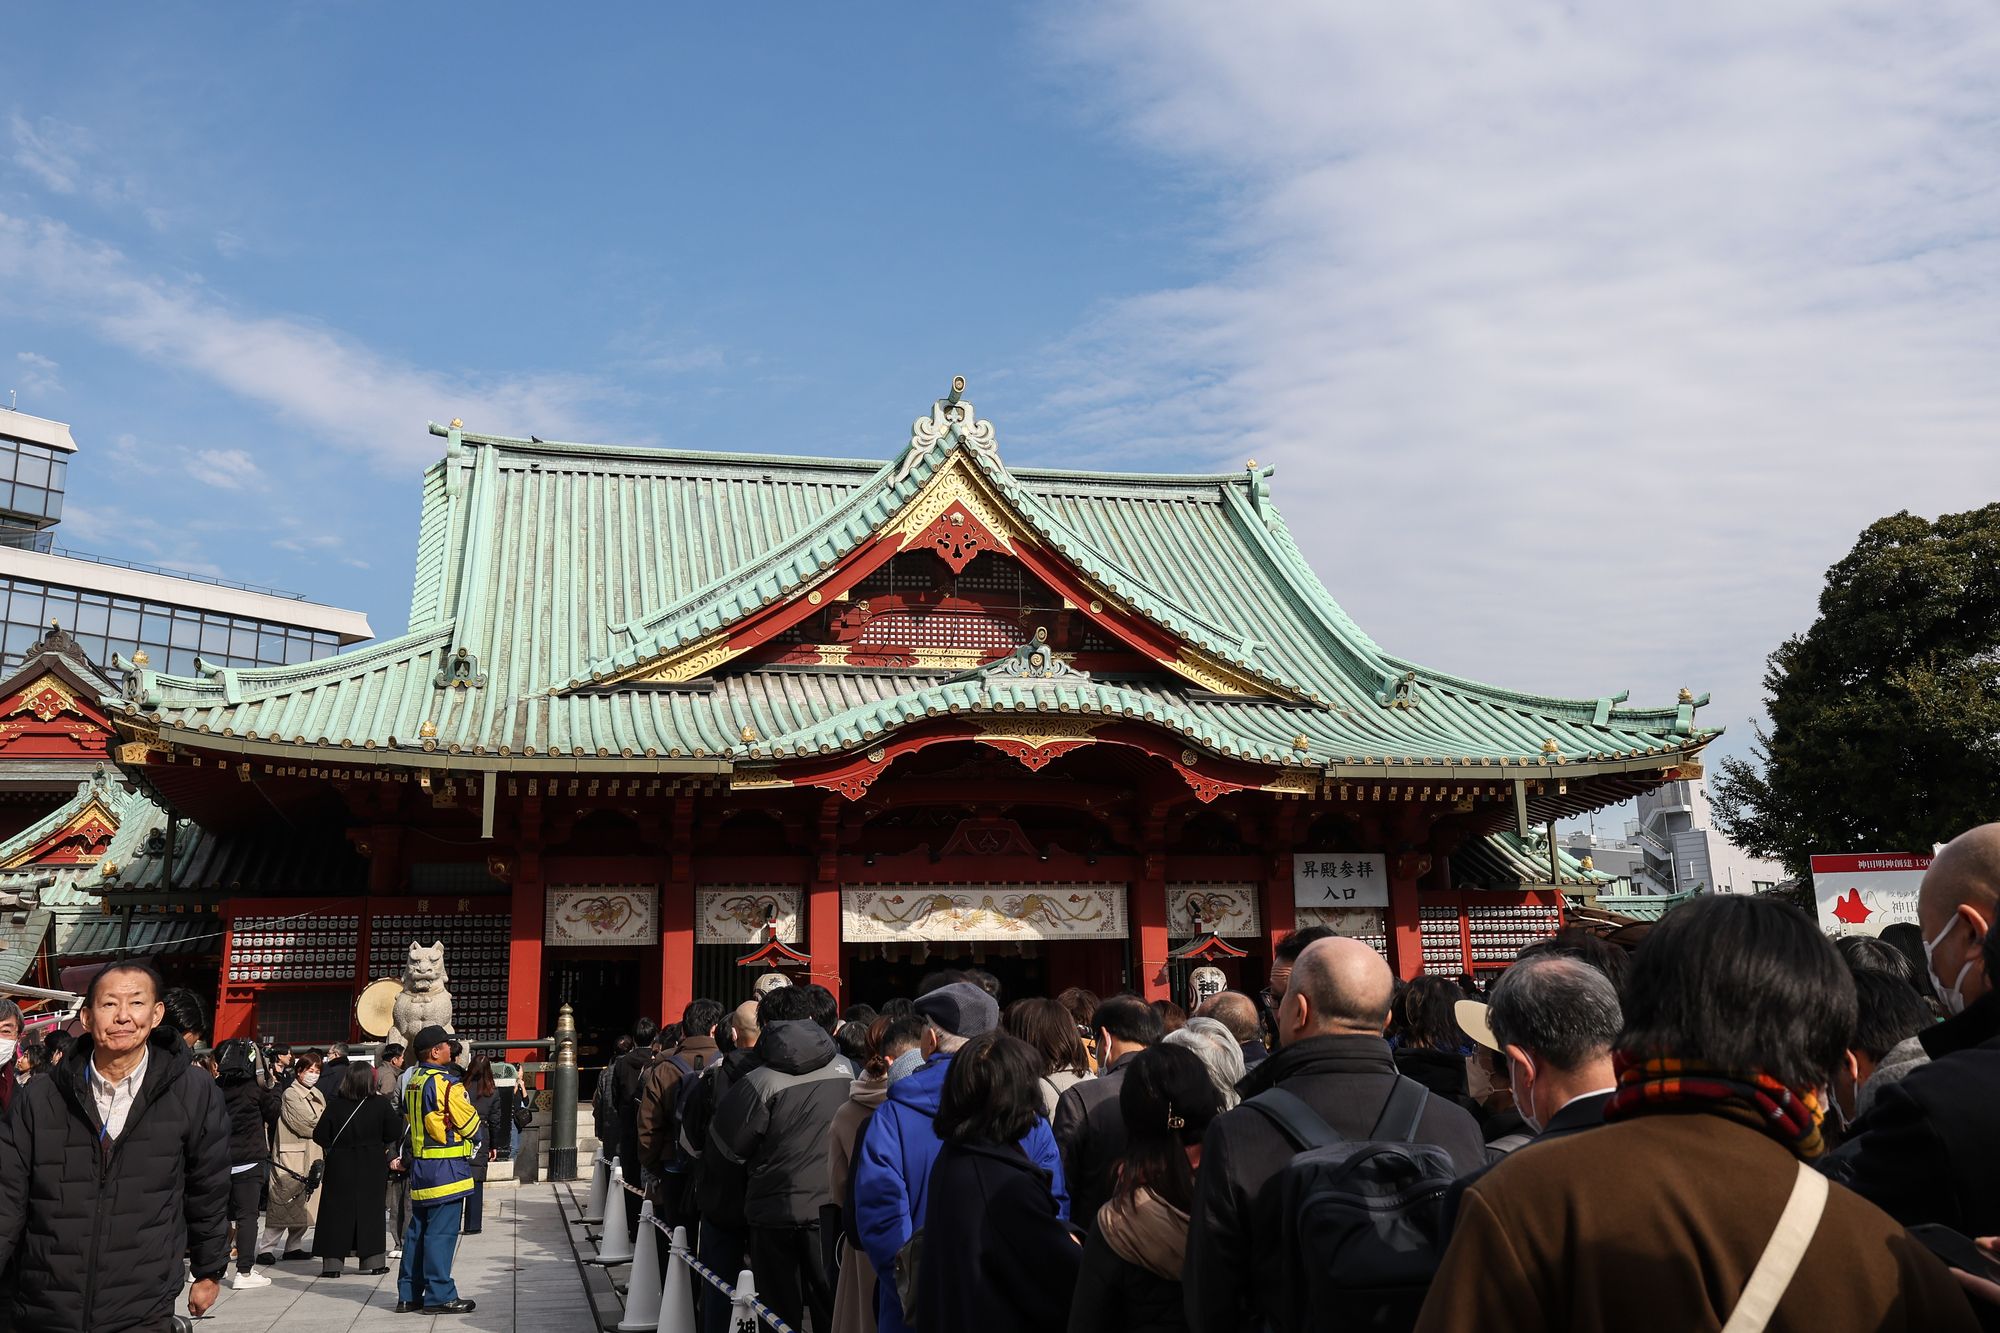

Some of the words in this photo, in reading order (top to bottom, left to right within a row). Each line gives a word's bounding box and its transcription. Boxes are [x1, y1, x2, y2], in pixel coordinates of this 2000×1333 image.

[1302, 861, 1374, 878] 昇殿参拝
[1323, 886, 1356, 900] 入口
[736, 1318, 756, 1333] 神
